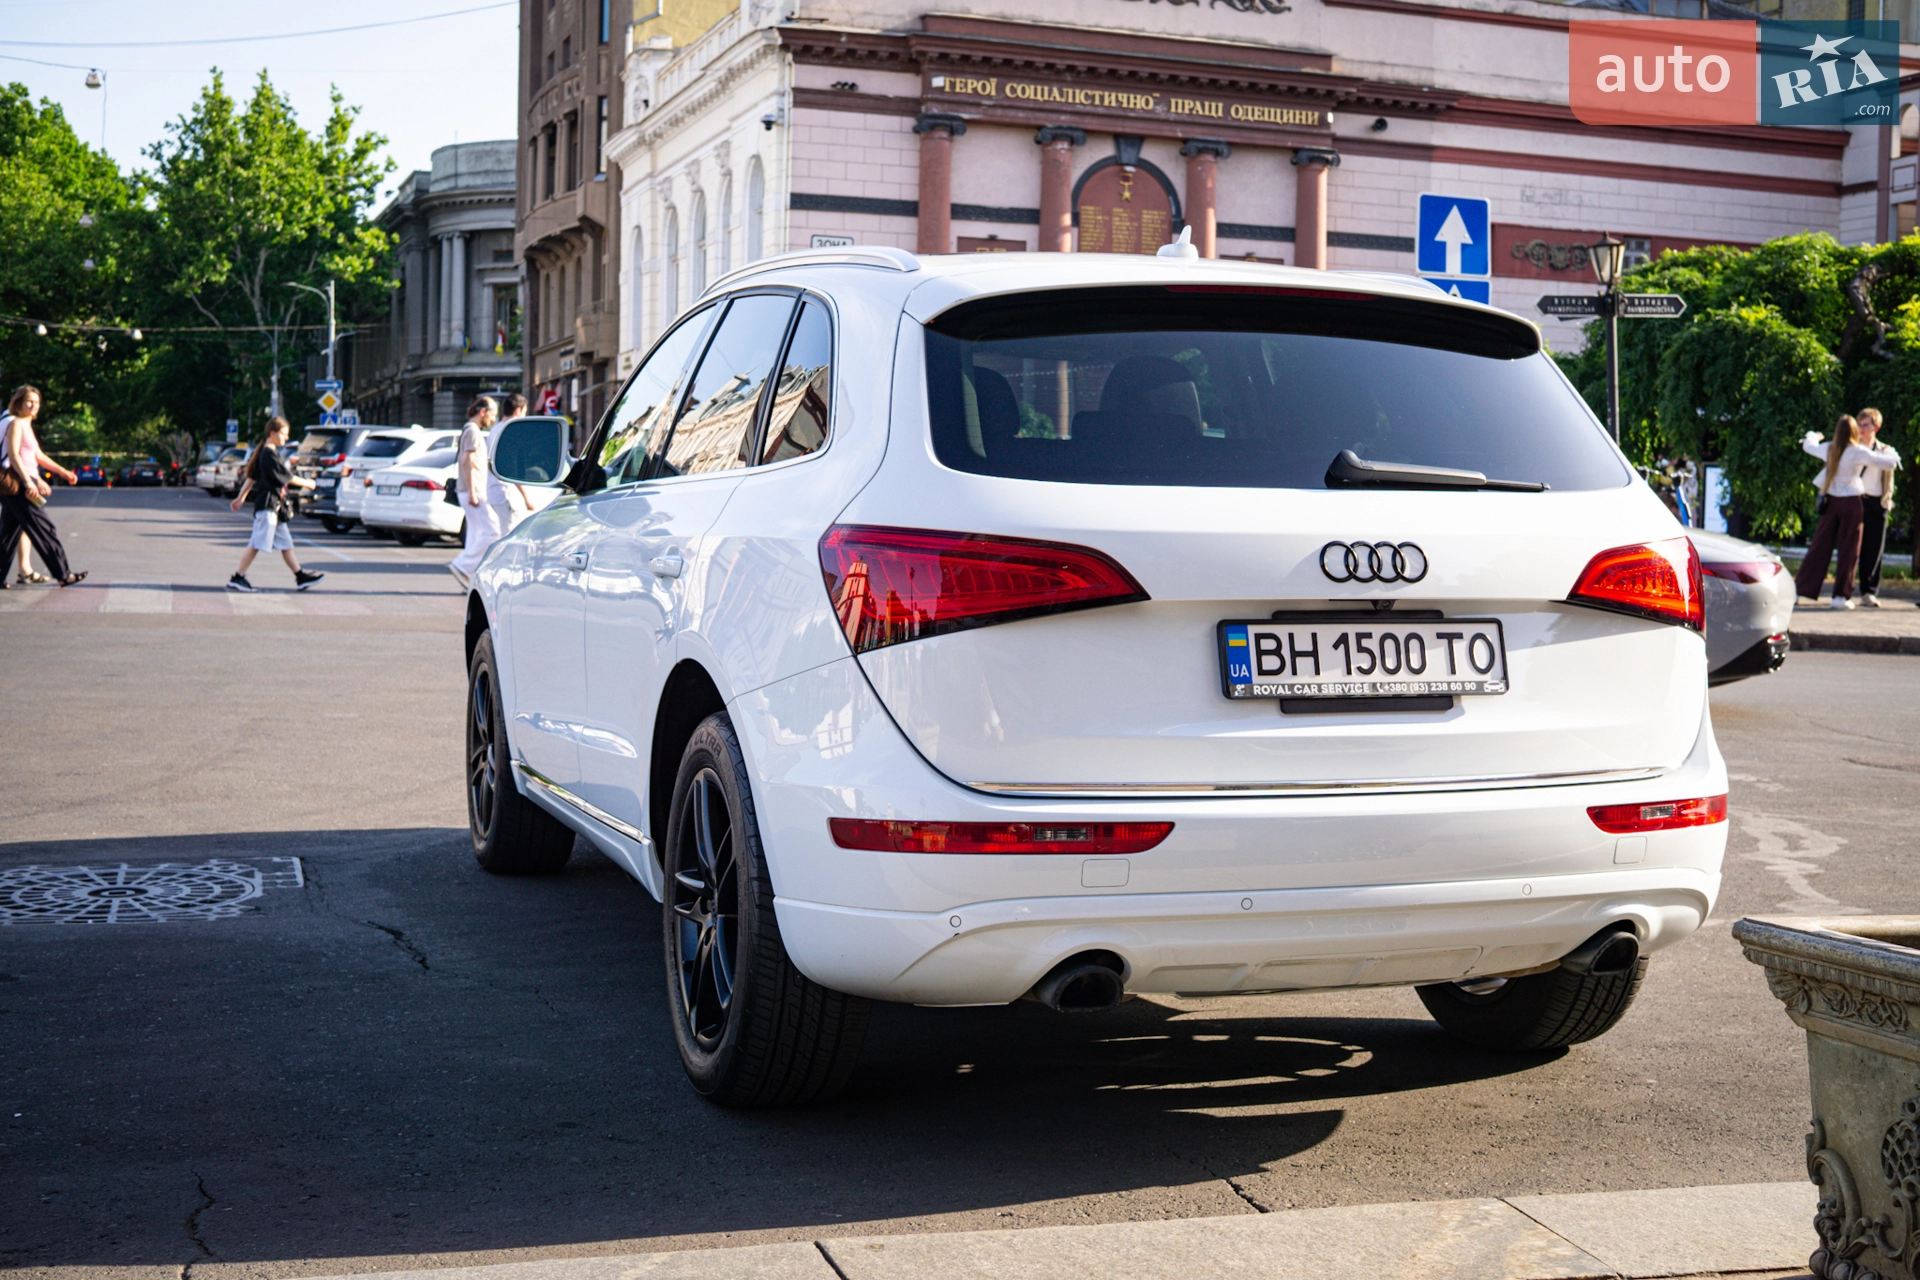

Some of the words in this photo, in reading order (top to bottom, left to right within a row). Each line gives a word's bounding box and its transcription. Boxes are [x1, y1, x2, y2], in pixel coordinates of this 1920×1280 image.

[944, 77, 998, 97] ГЕРОЇ
[1004, 82, 1160, 111] СОЦІАЛІСТИЧНО
[1170, 97, 1224, 119] ПРАЦІ
[1230, 104, 1320, 126] ОДЕЩИНИ
[1254, 632, 1321, 676] BH
[1332, 632, 1427, 675] 1500
[1436, 632, 1495, 675] TO
[1230, 663, 1250, 678] UA
[1253, 684, 1291, 695] ROYAL
[1294, 683, 1319, 694] CAR
[1321, 683, 1369, 694] SERVICE
[1384, 682, 1407, 692] +380
[1410, 682, 1429, 693] (93)
[1430, 682, 1448, 691] 238
[1450, 682, 1462, 691] 60
[1464, 681, 1477, 691] 90
[694, 731, 722, 757] ULTRA
